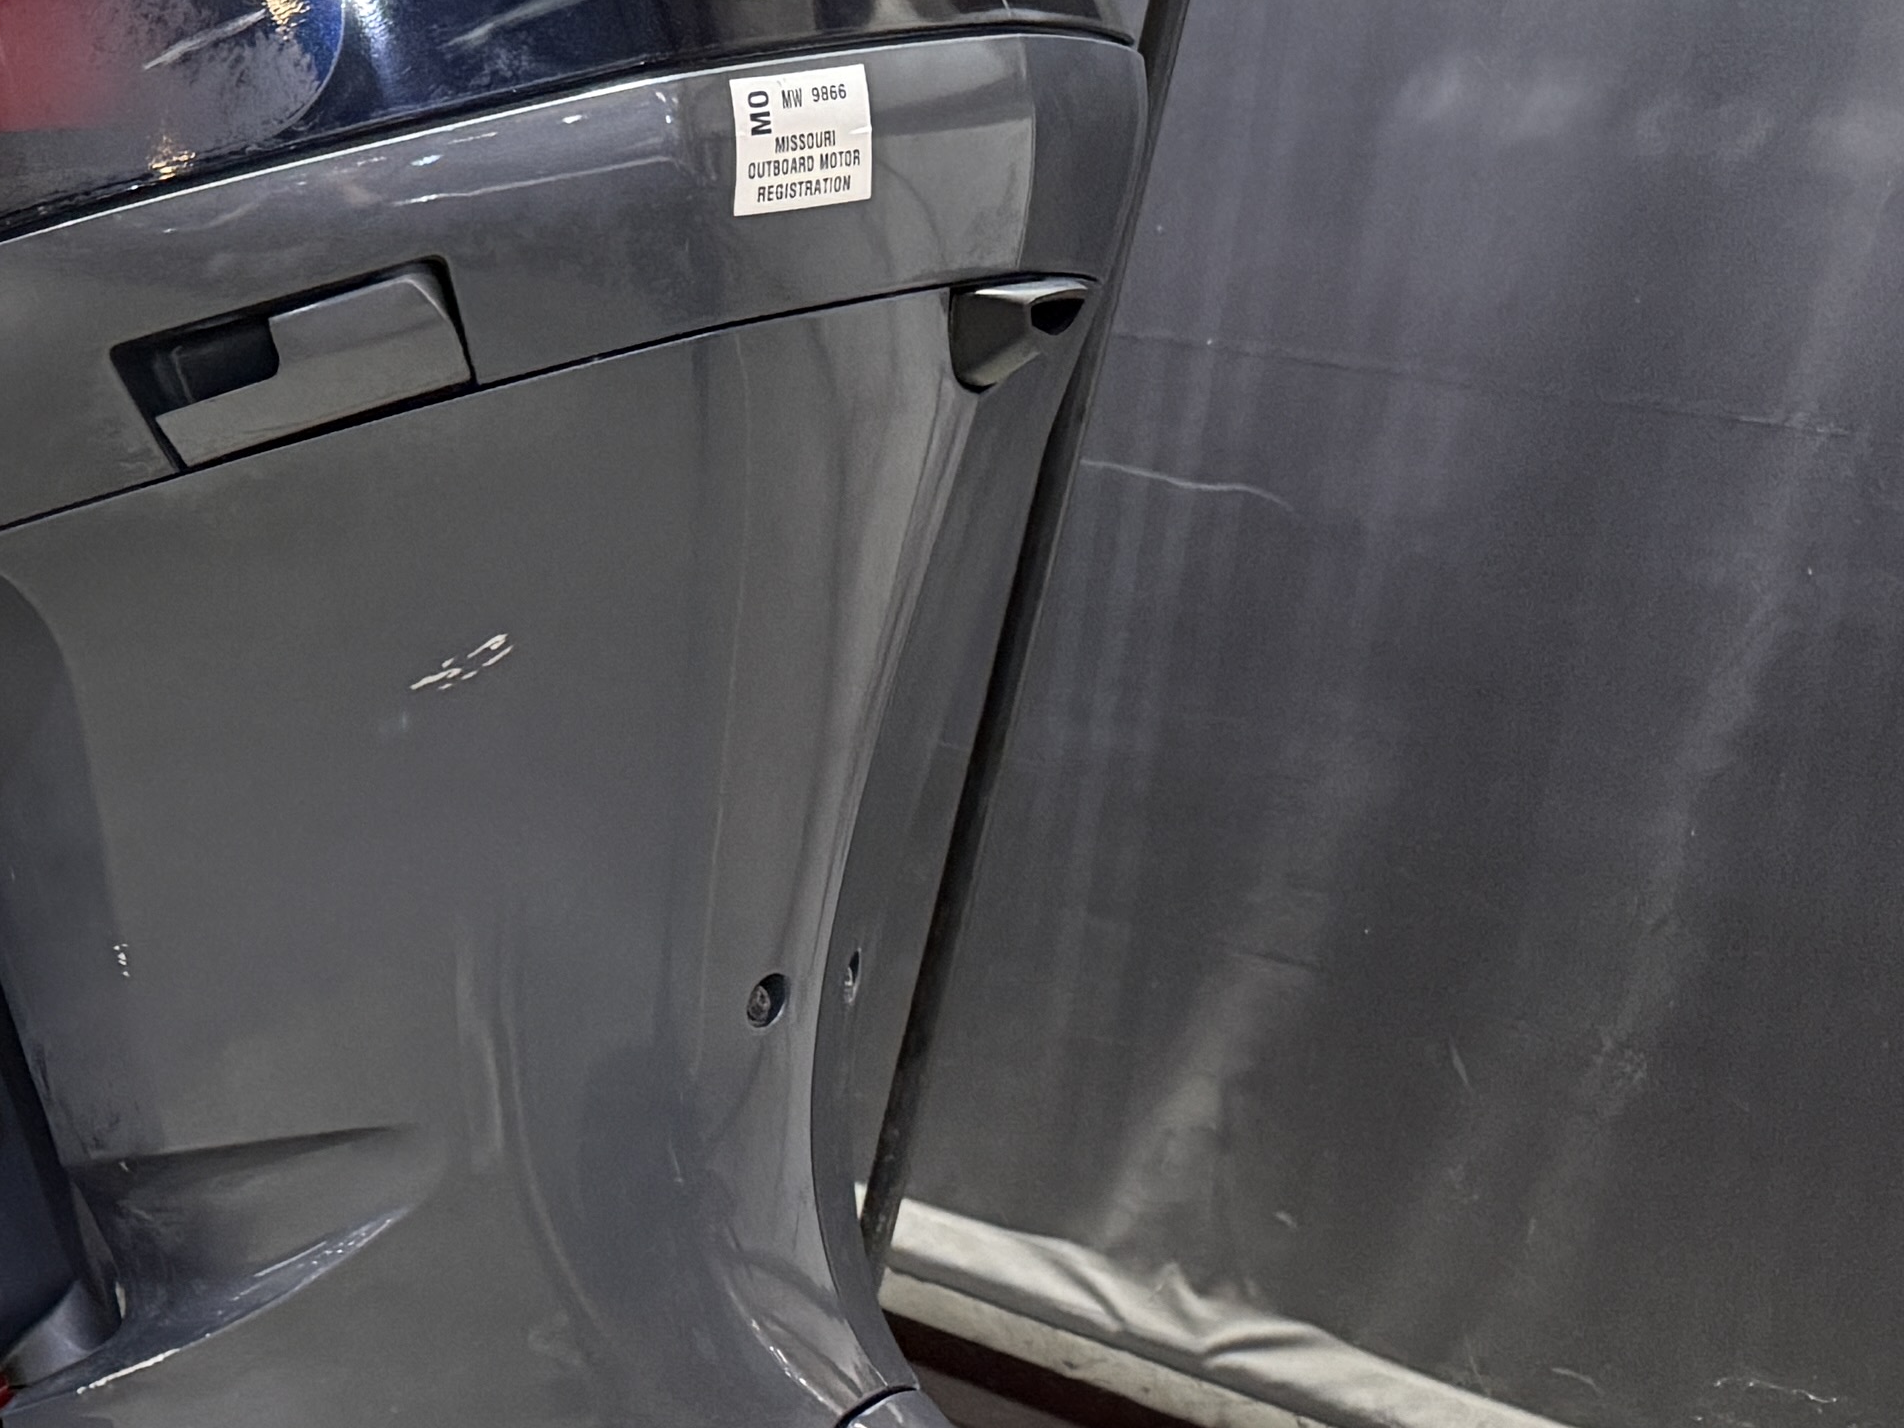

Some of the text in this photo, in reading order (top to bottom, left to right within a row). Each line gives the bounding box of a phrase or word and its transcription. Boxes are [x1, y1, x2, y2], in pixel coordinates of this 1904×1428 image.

[747, 83, 848, 137] MO MW 9866
[774, 129, 837, 154] MISSOURI
[748, 149, 861, 180] OUTBOARD MOTOR
[756, 175, 852, 204] REGISTRATION
